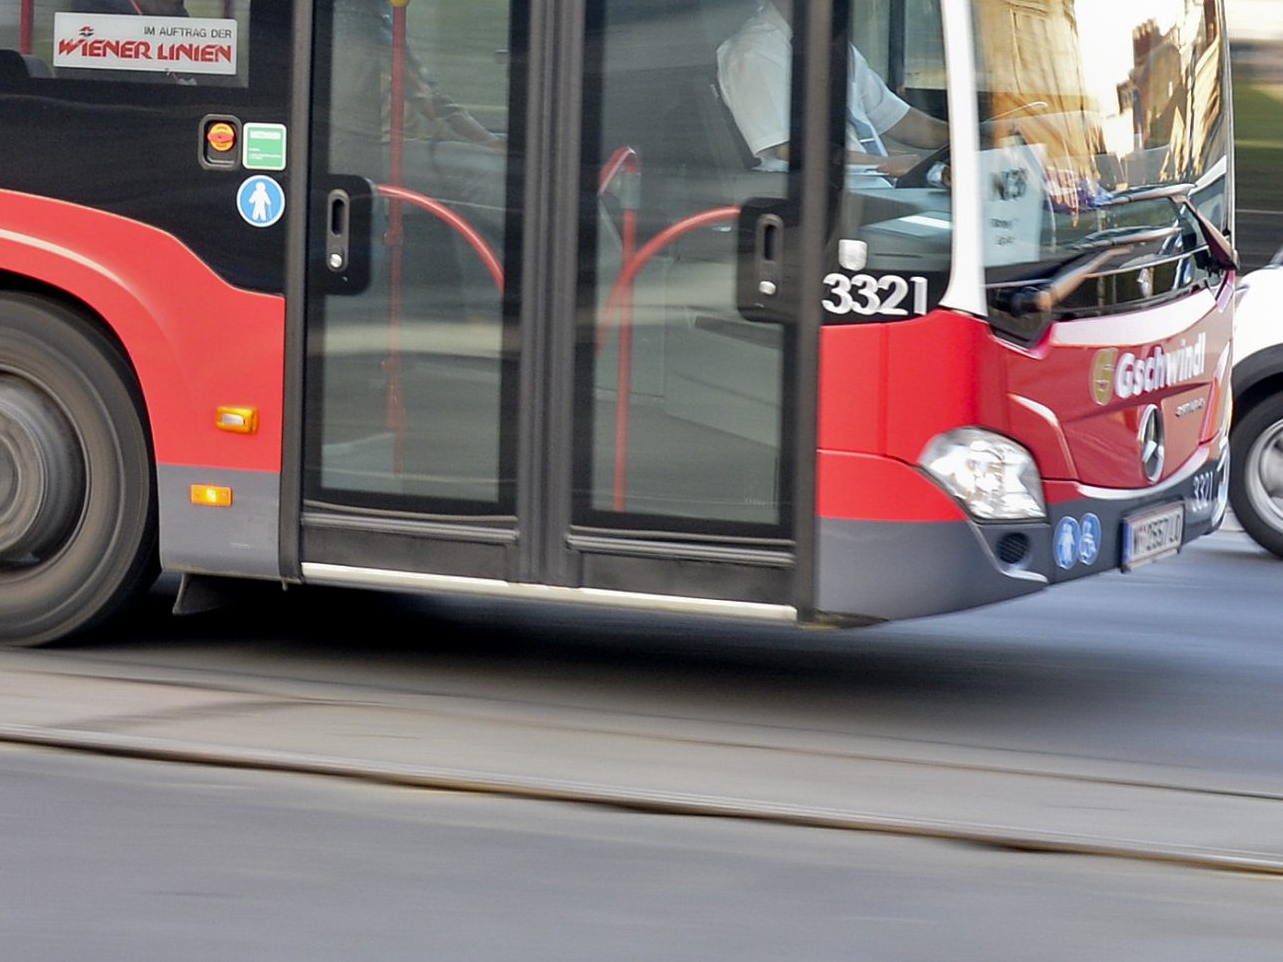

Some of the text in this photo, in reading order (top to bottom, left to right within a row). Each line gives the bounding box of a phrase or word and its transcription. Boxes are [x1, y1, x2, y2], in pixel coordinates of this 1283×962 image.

[143, 26, 232, 39] IM AUFTRAG DER
[58, 39, 231, 63] WIENER LINIEN
[821, 272, 928, 316] 3321
[1115, 332, 1206, 399] Gschwindl
